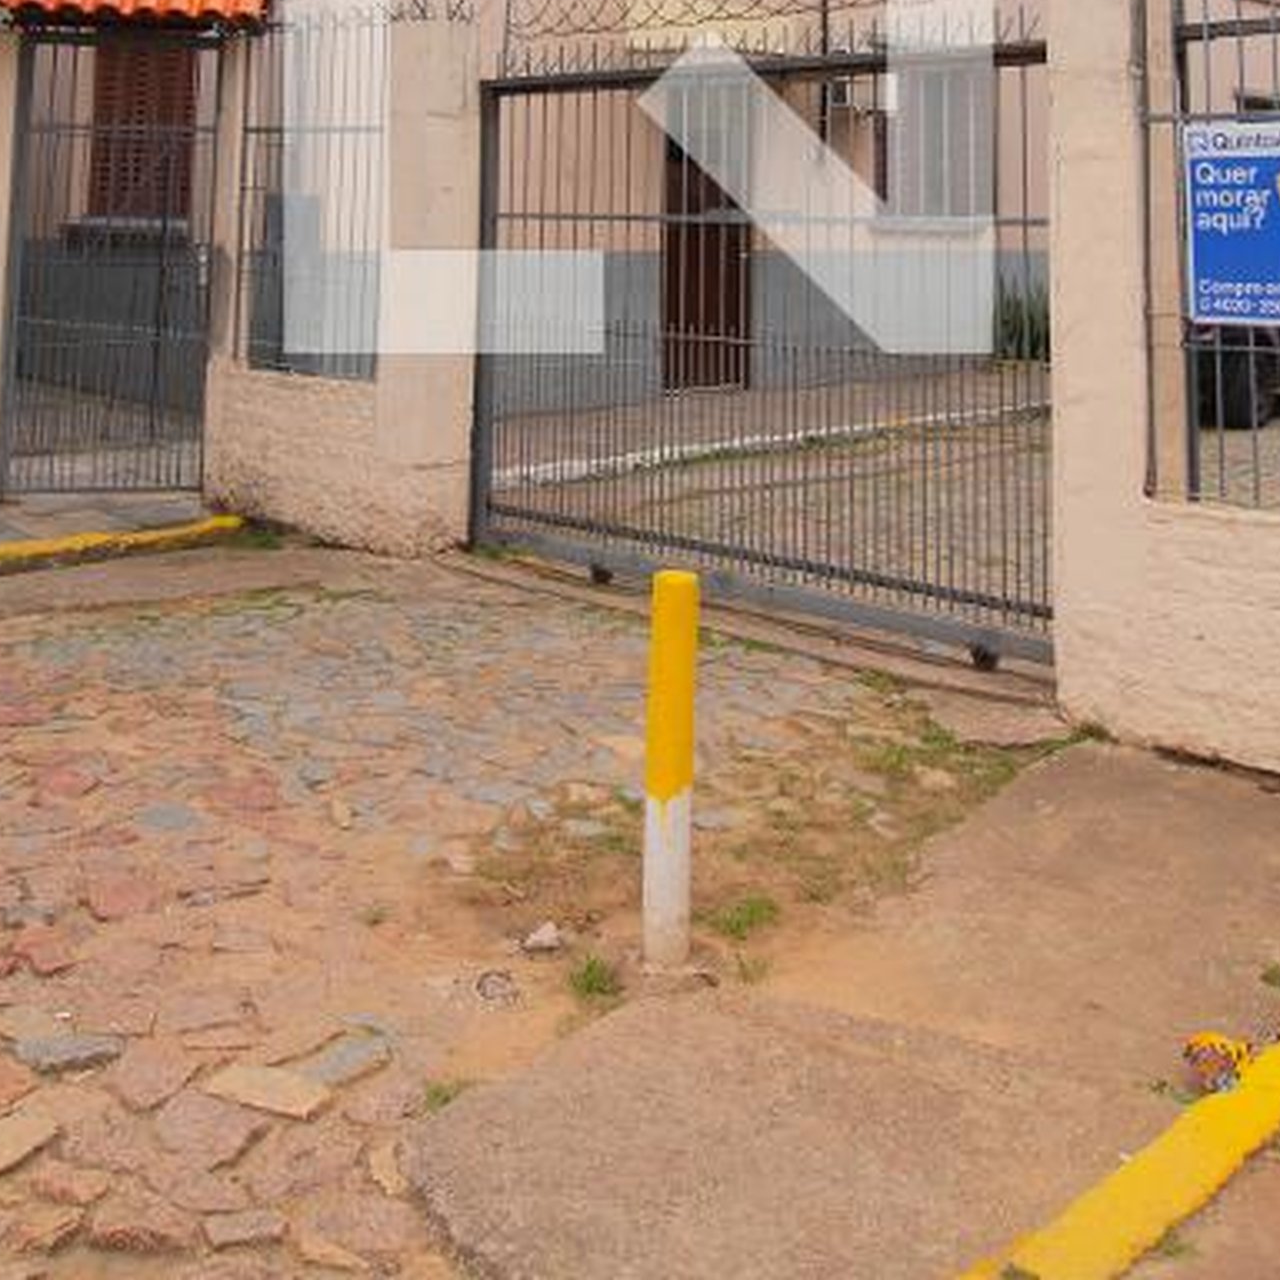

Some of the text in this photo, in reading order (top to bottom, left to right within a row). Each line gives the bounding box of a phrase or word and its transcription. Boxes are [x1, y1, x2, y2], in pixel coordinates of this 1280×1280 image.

[1195, 162, 1257, 185] Quer
[1195, 188, 1270, 208] morar
[1197, 206, 1265, 235] aqui?
